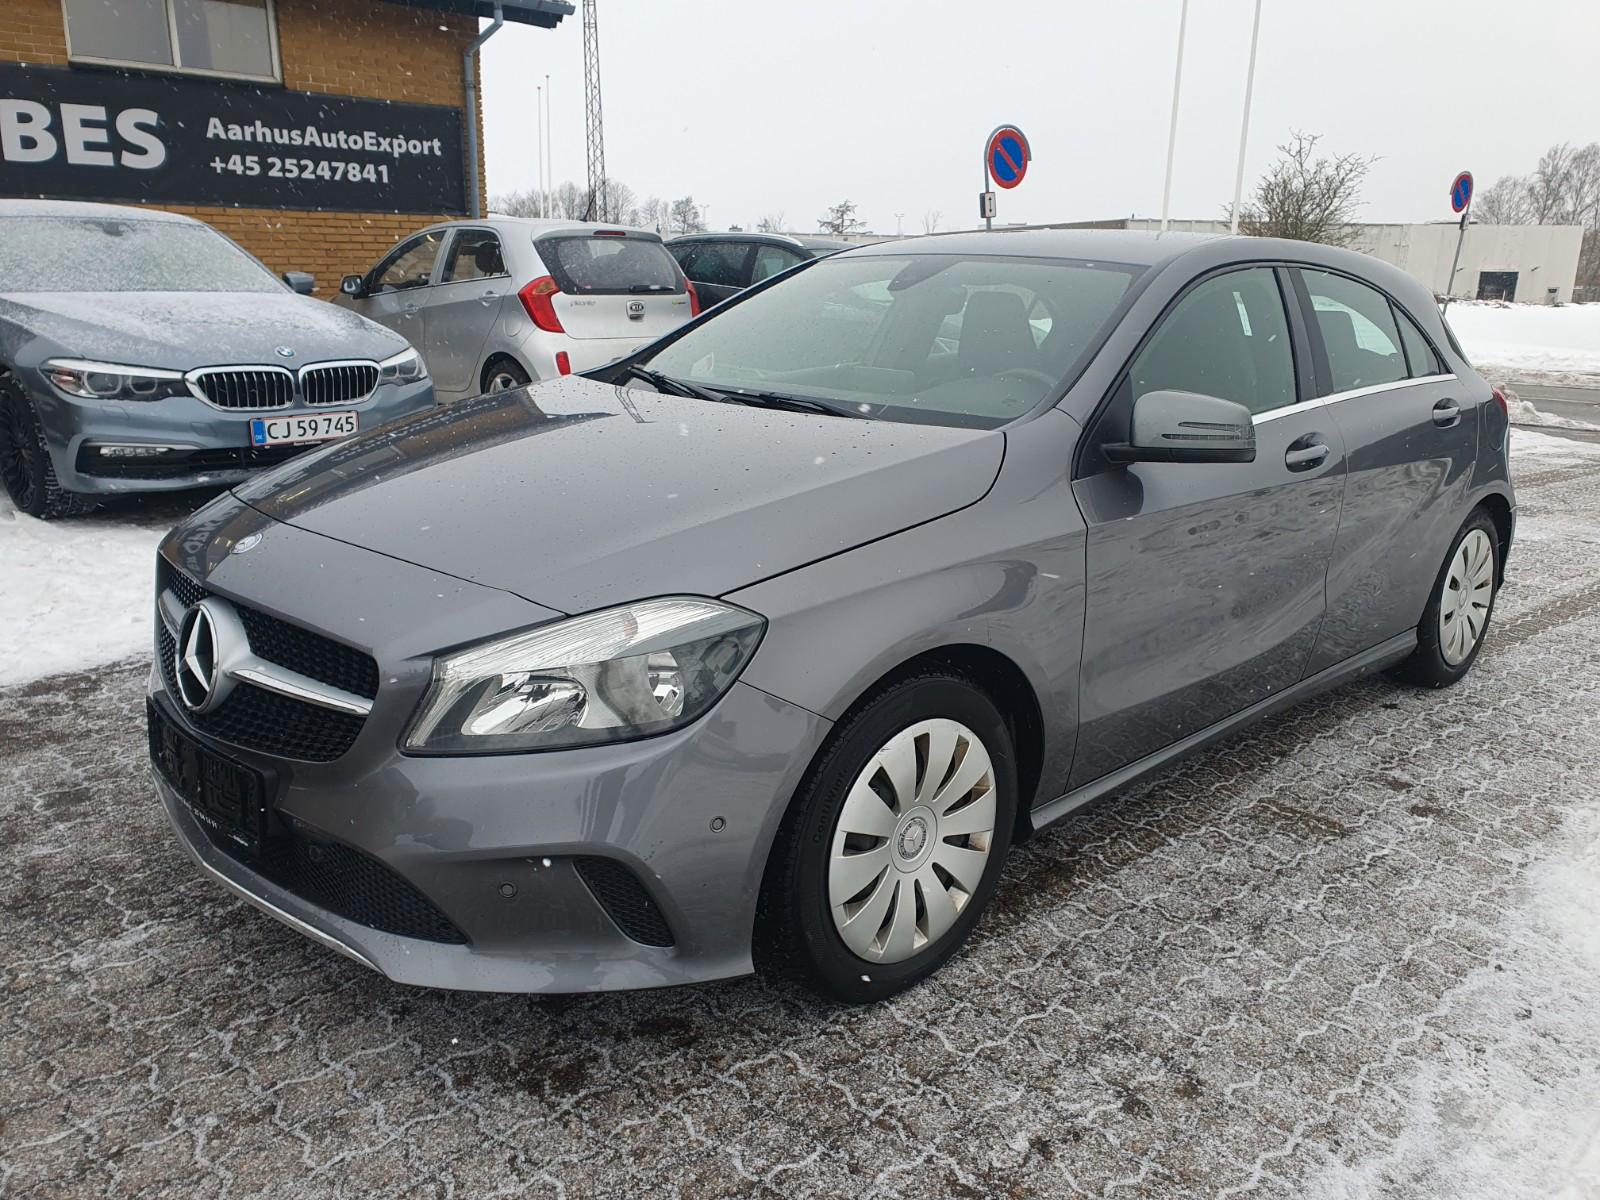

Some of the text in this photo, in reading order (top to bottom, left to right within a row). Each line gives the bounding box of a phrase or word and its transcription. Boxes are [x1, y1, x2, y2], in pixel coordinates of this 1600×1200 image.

[0, 99, 166, 170] BES
[206, 117, 442, 157] AarhusAutoExport
[210, 154, 390, 184] +45 25247841
[267, 415, 355, 440] CJ 59 745
